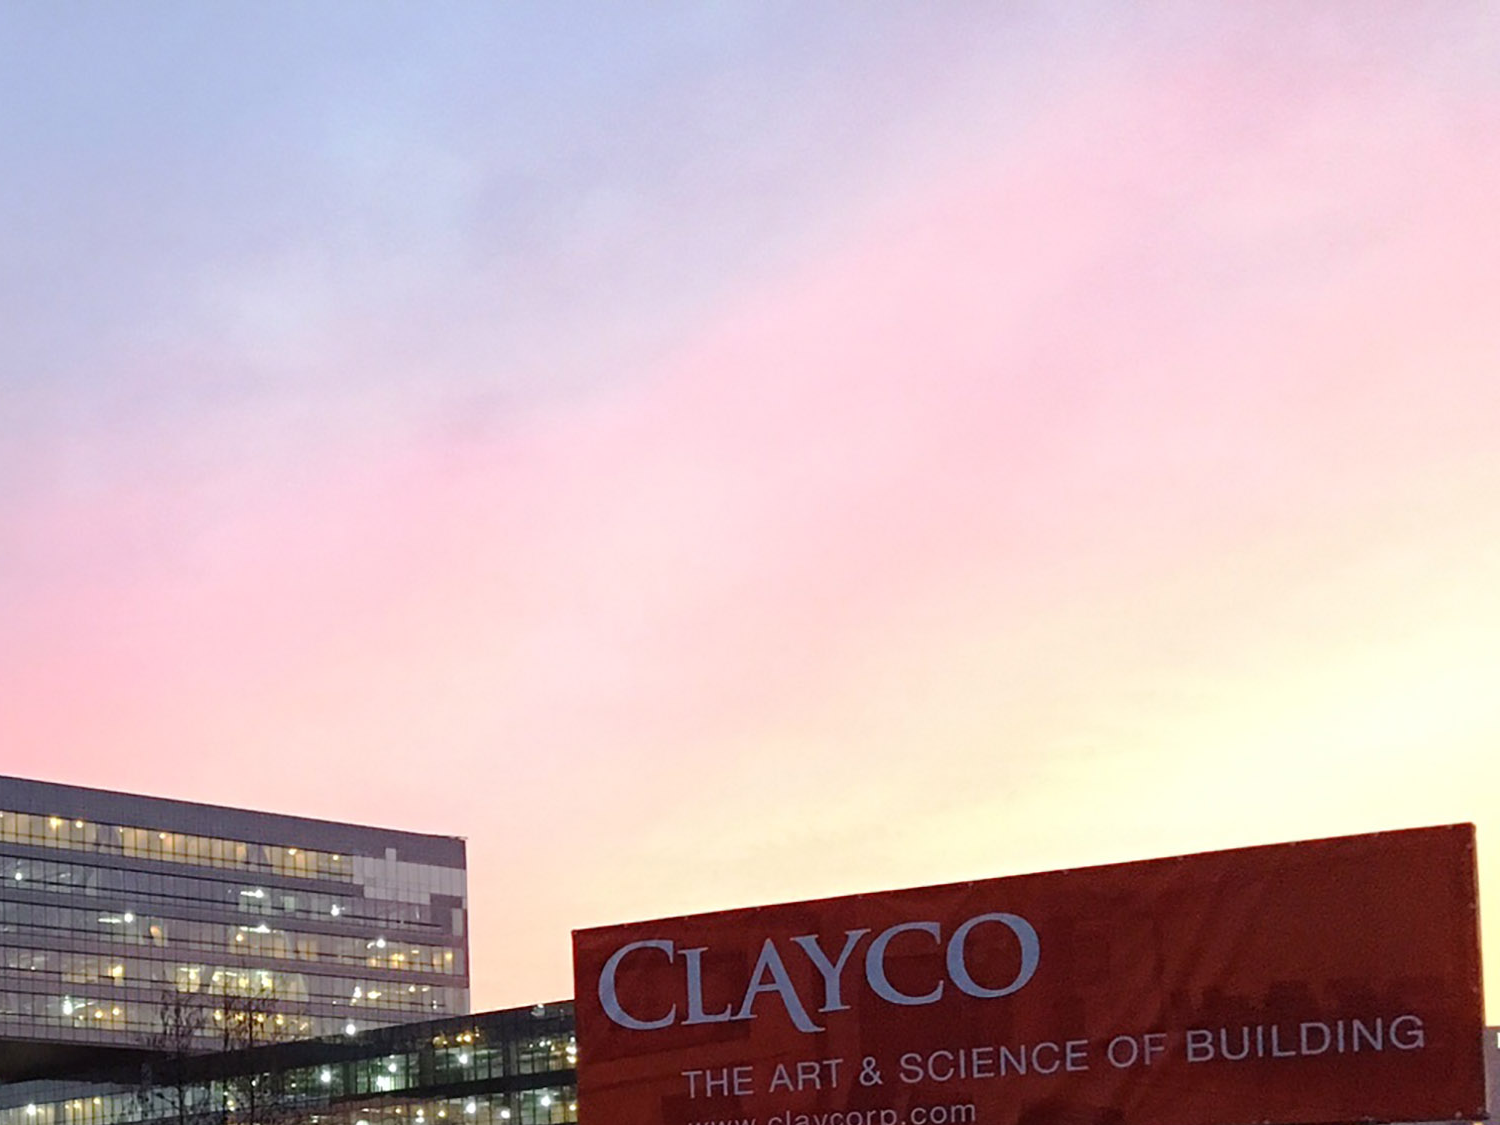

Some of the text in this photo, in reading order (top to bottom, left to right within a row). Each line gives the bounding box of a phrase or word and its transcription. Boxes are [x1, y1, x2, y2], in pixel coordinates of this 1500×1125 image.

[598, 913, 1040, 1032] CLAYCO
[681, 1015, 1424, 1099] THE ART & SCIENCE OF BUILDING
